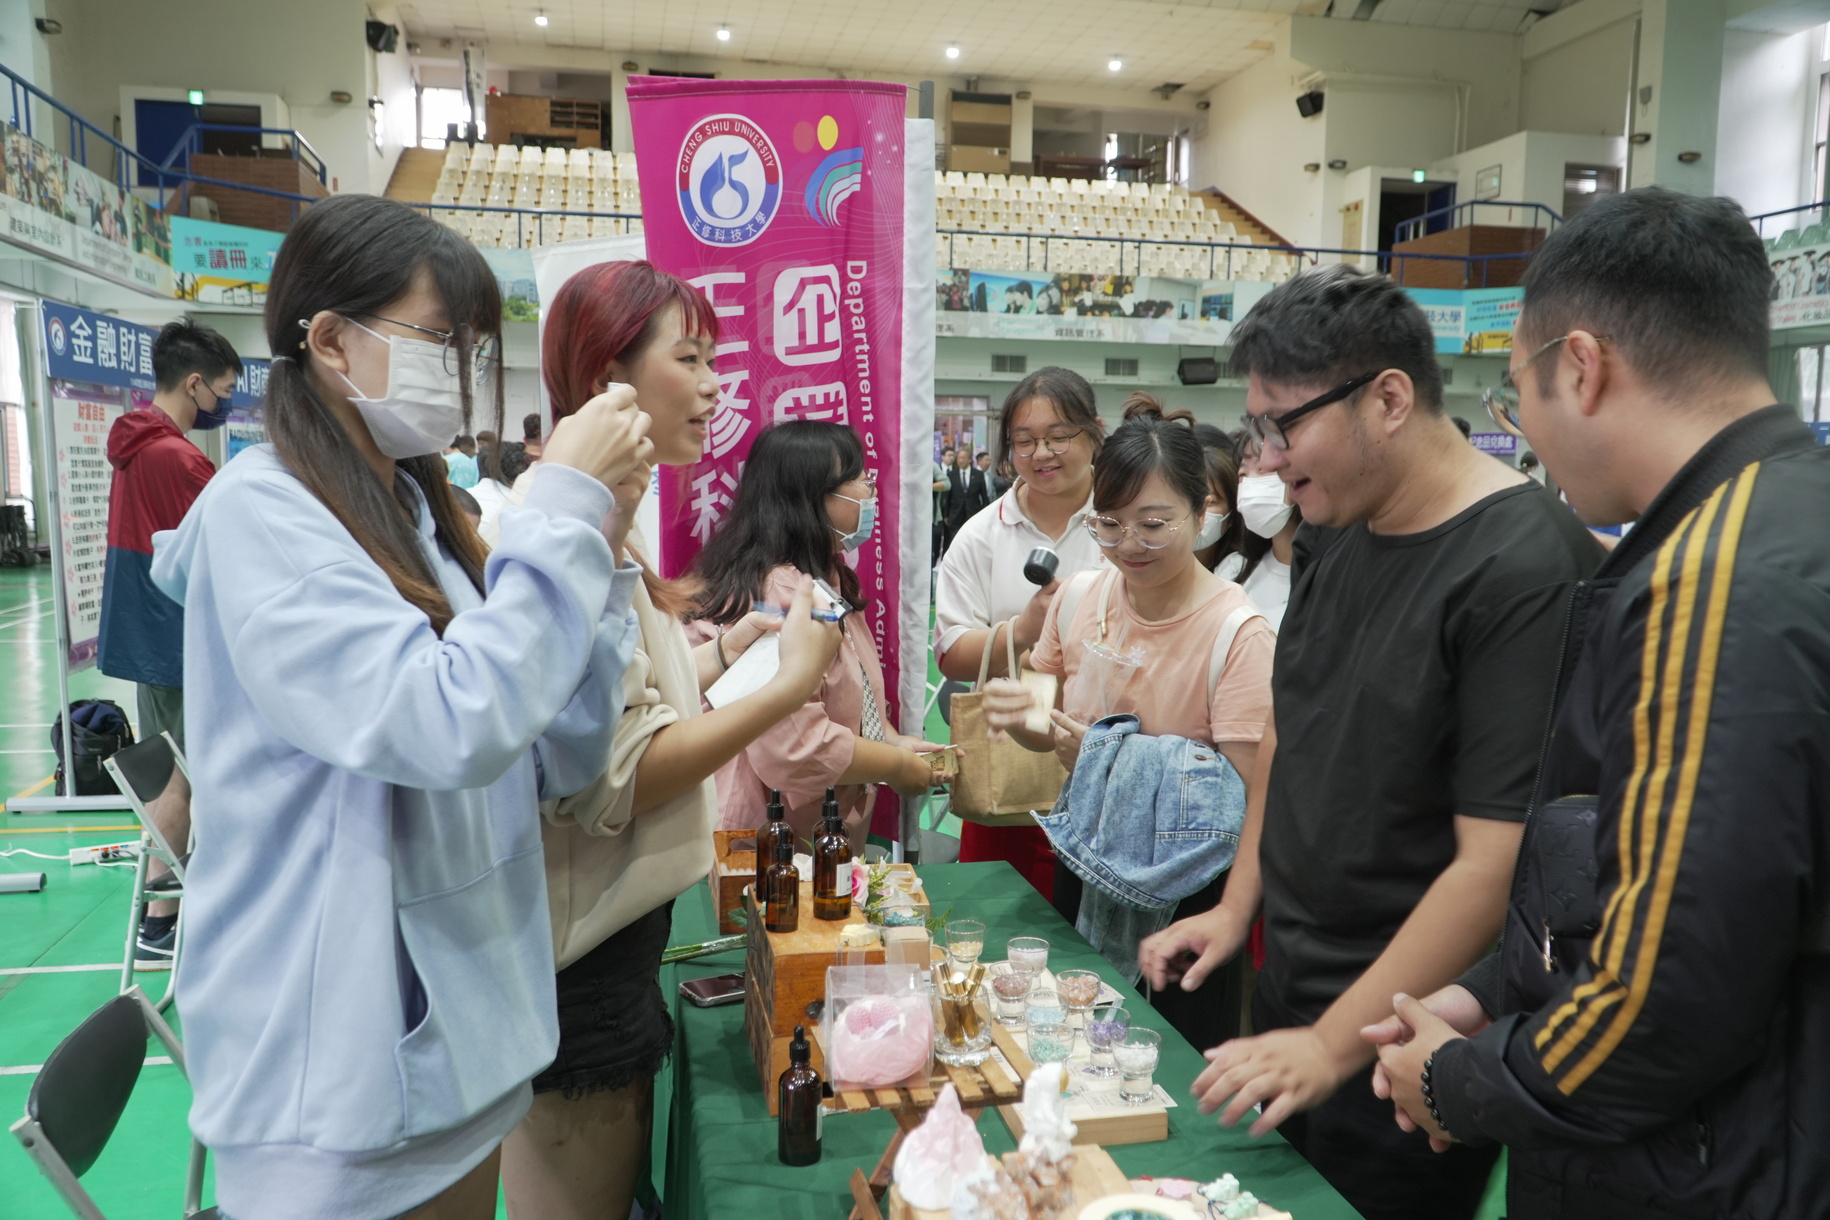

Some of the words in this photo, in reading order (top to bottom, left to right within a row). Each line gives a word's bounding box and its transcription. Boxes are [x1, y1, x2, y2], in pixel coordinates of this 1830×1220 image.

[681, 132, 703, 173] CHENG
[705, 121, 730, 135] SHIU
[734, 121, 775, 167] UNIVERSITY
[692, 211, 767, 242] 正修科技大學
[69, 314, 154, 376] 金融財富
[845, 260, 874, 422] Department
[865, 431, 878, 459] of
